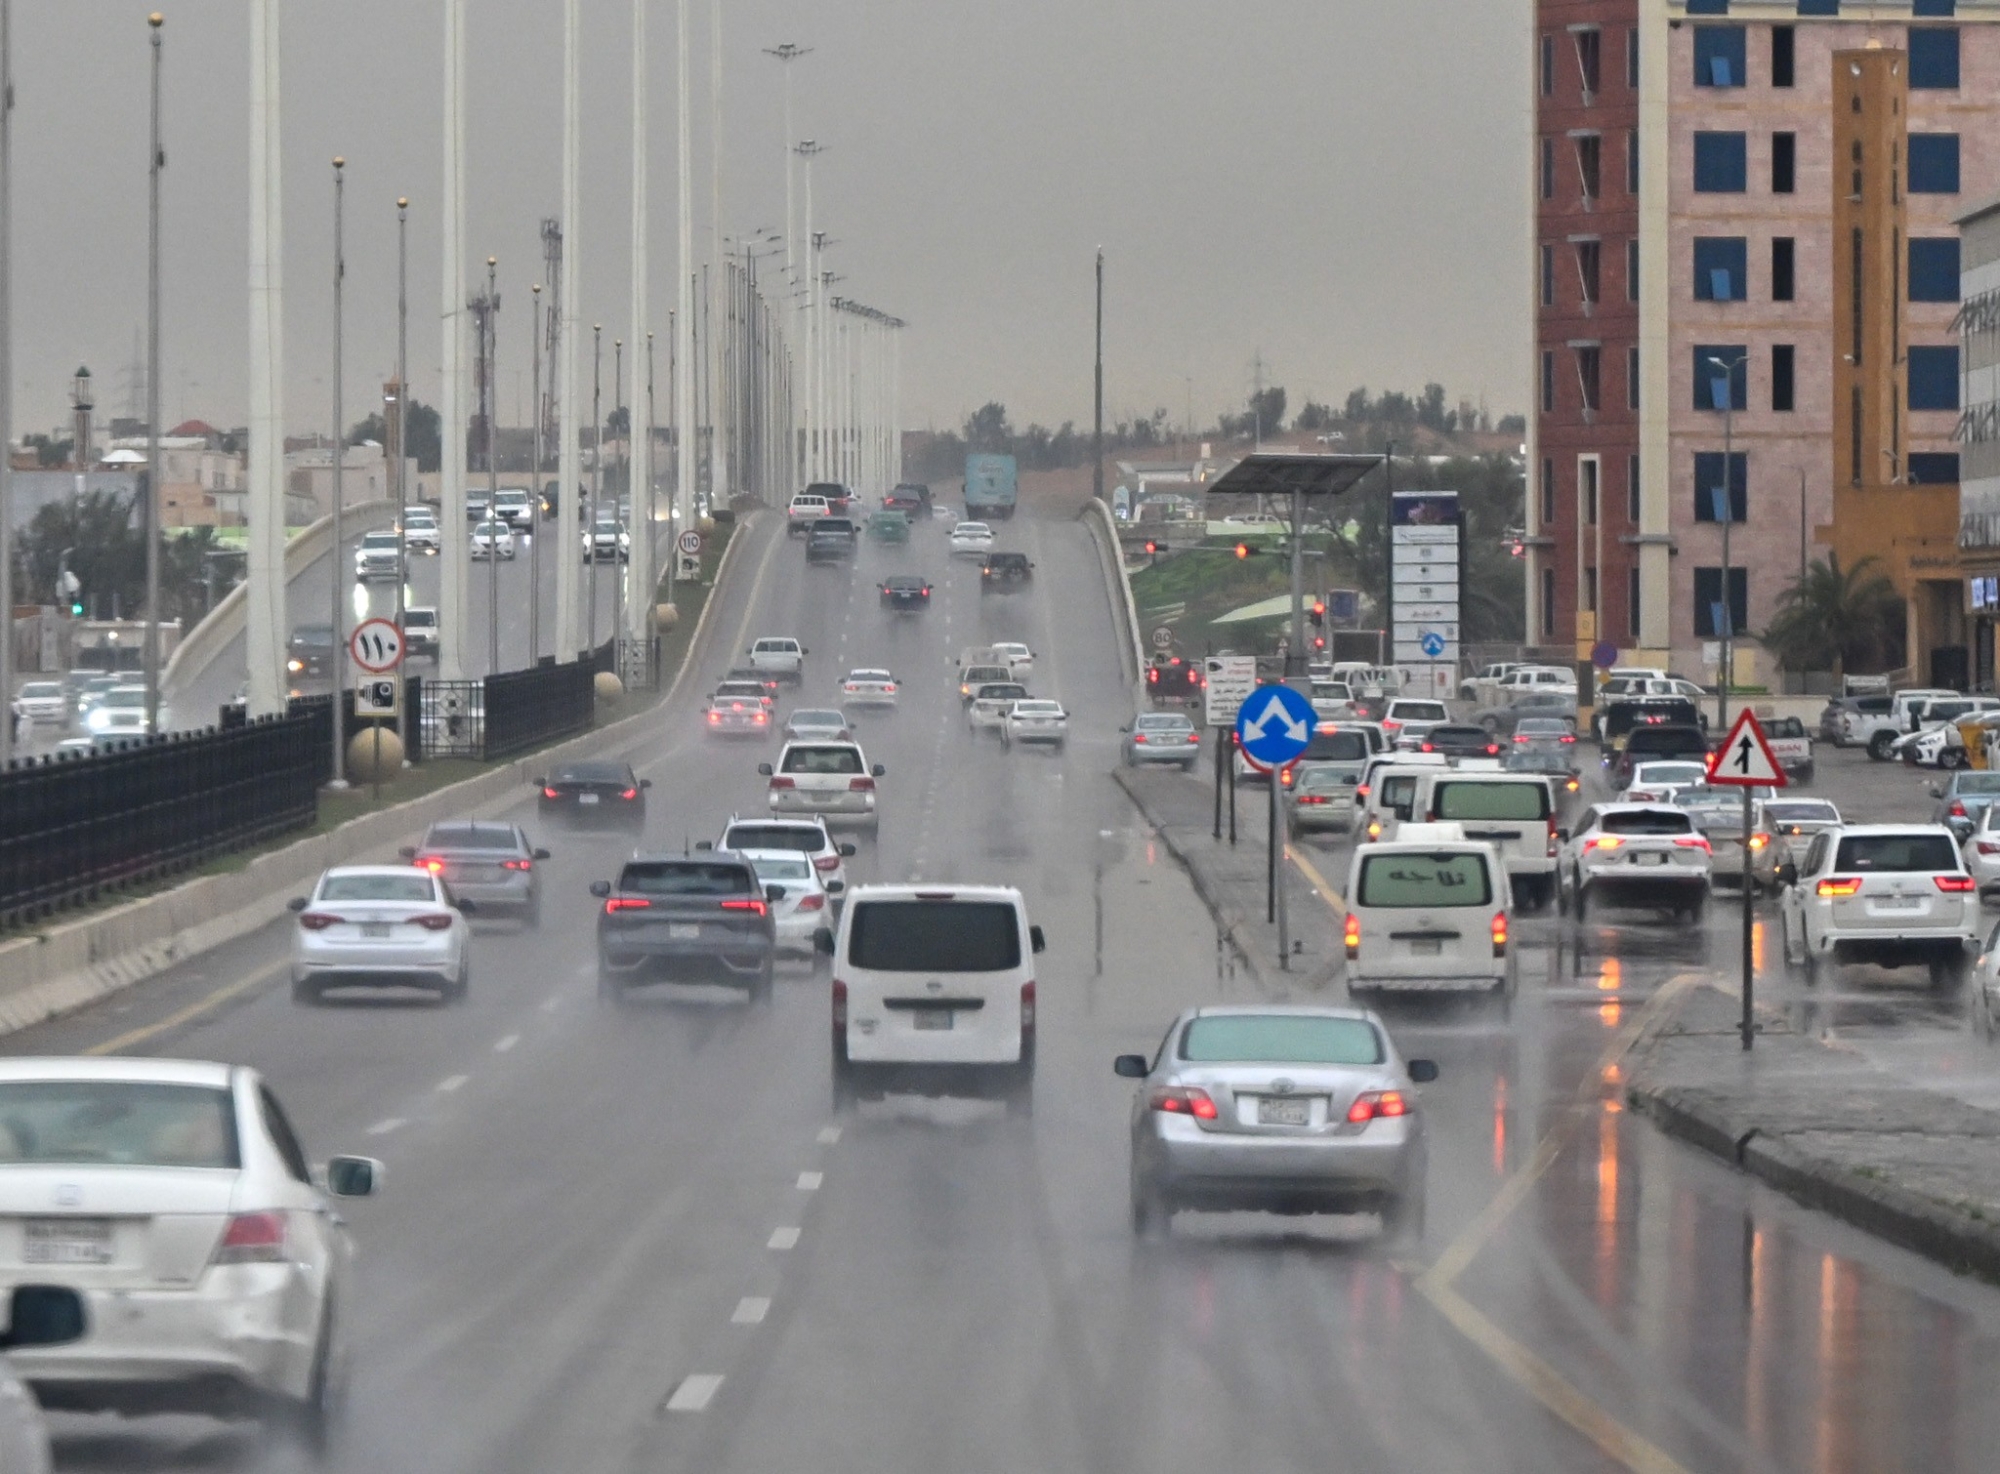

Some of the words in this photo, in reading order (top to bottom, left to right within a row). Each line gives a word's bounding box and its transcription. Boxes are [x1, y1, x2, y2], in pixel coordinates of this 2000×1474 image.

[683, 536, 699, 548] 110
[1155, 632, 1171, 643] 80
[1770, 743, 1802, 753] SSAN
